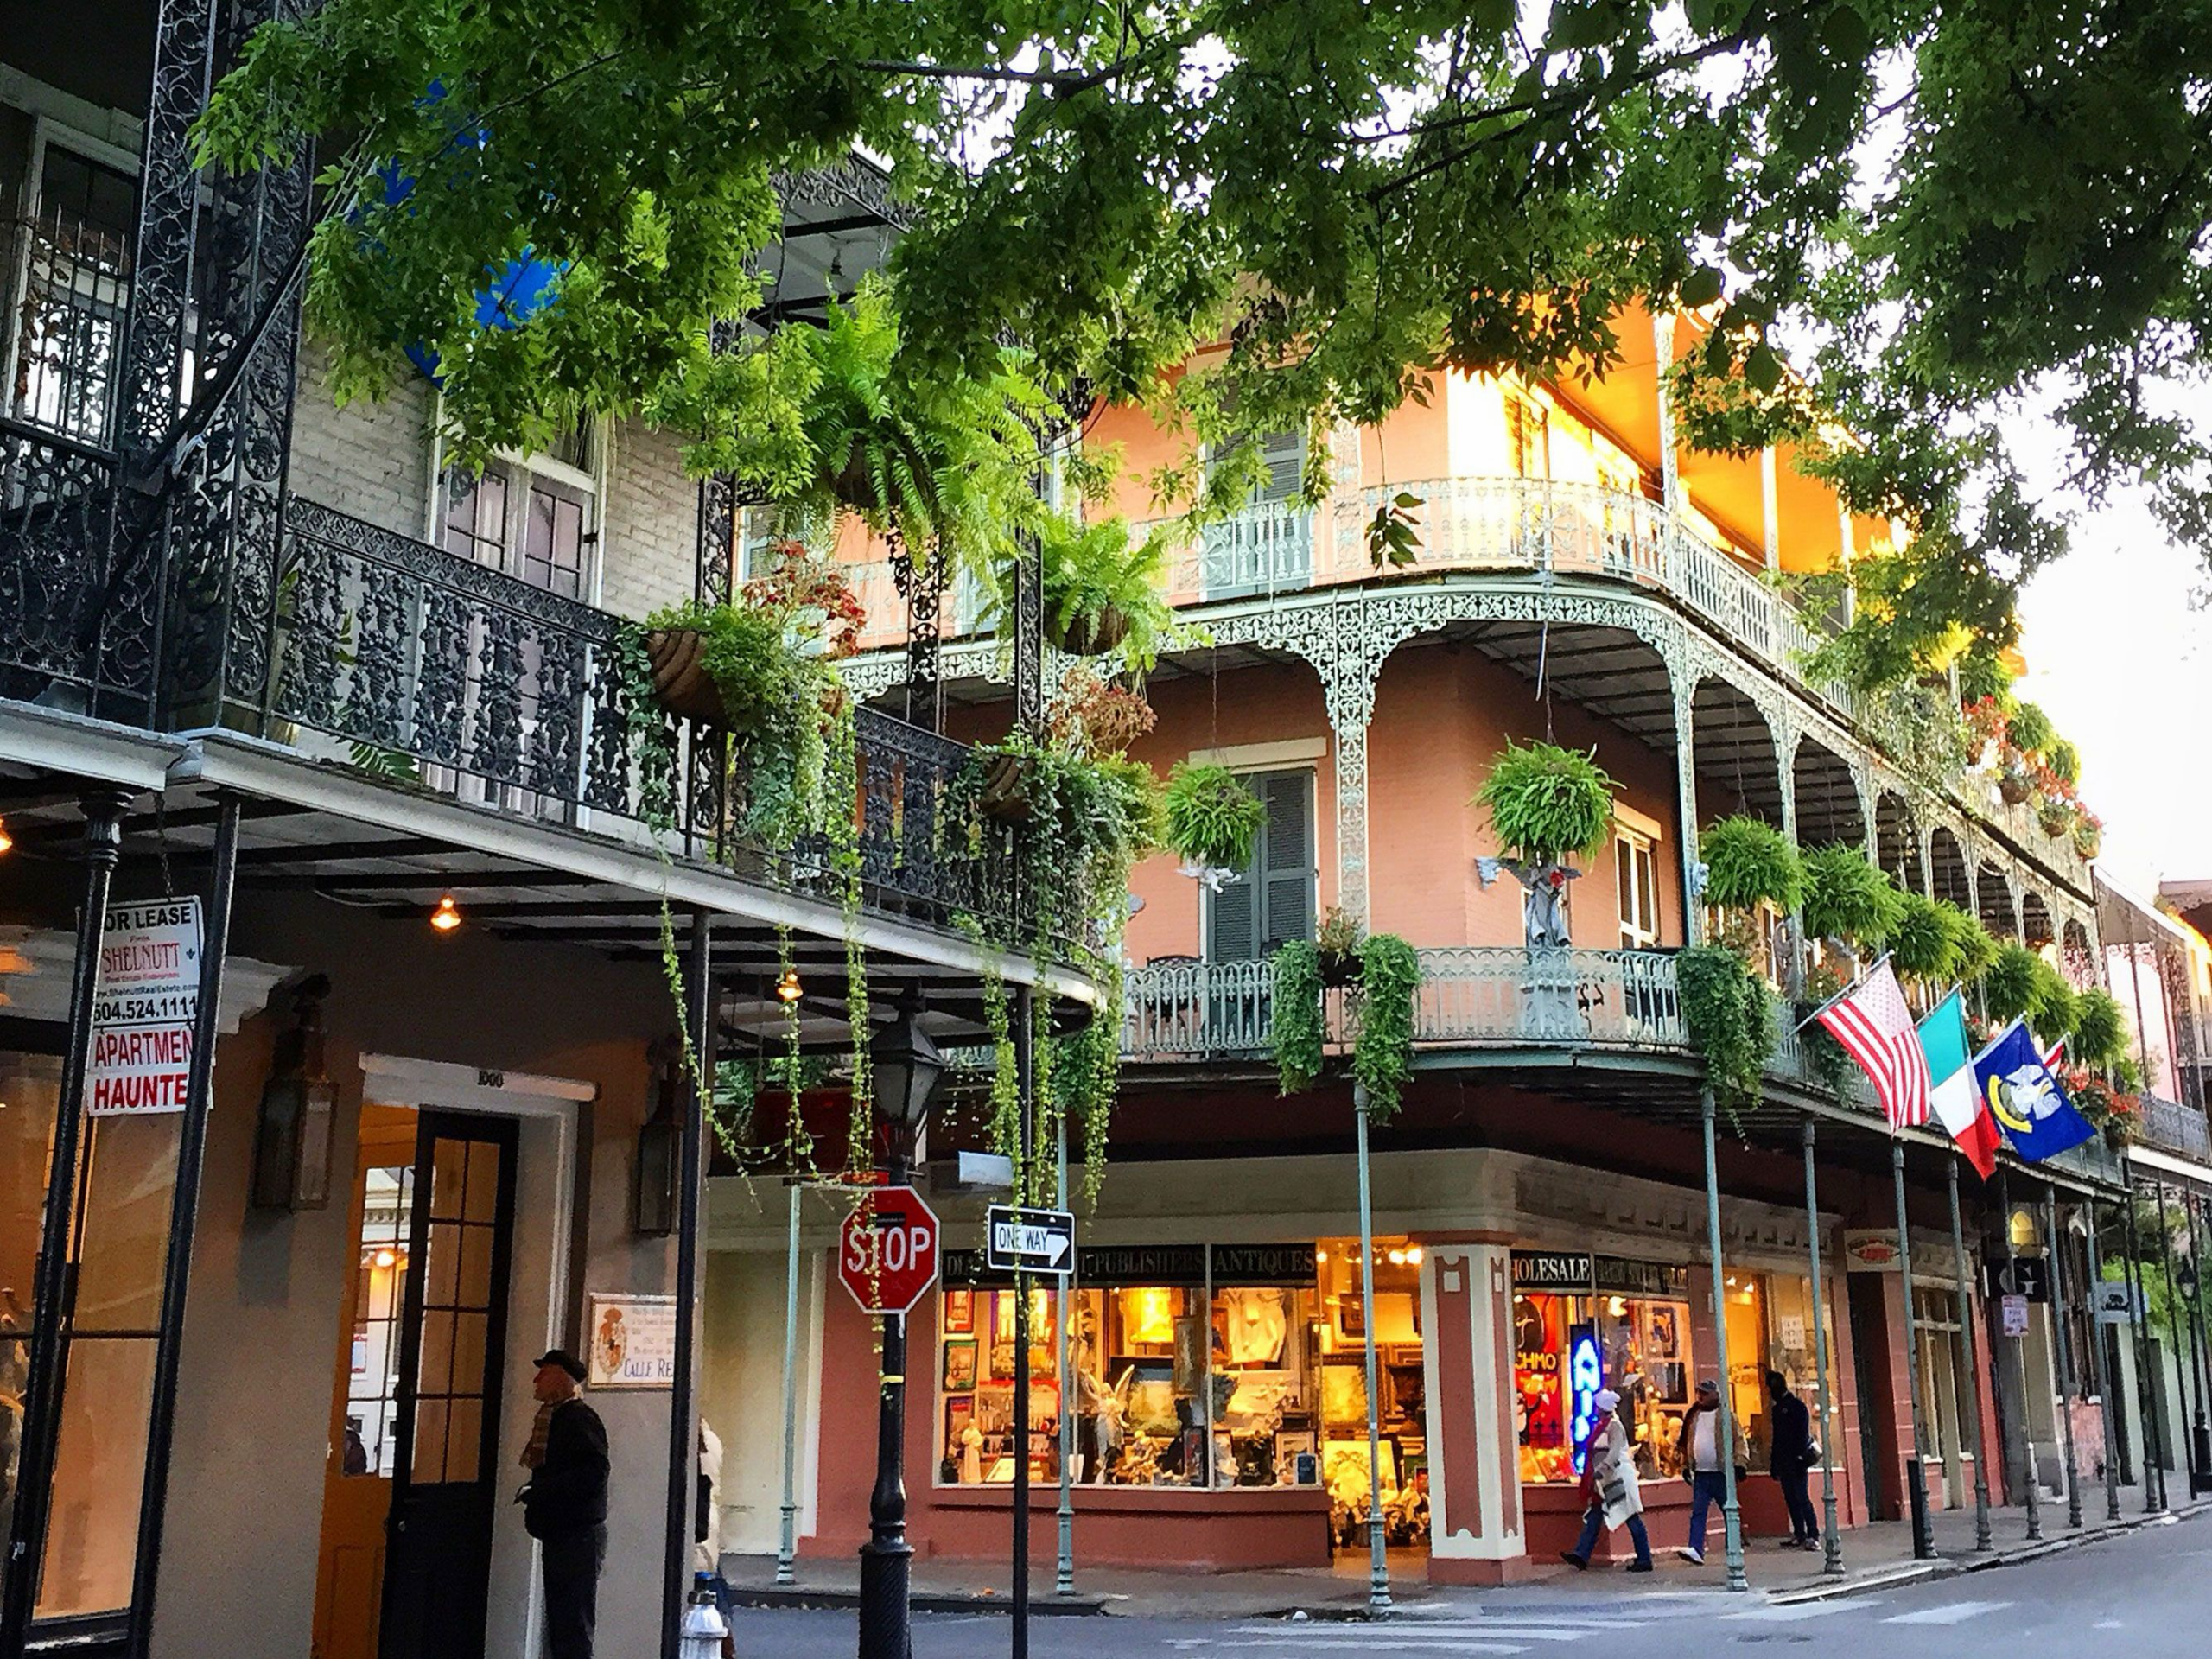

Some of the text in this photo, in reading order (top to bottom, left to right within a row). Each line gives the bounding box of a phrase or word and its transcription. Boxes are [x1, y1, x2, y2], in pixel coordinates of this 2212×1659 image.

[104, 906, 192, 932] OR LEASE
[101, 943, 181, 974] SHELNUTT
[94, 1028, 194, 1067] APARTMEN
[94, 1073, 188, 1111] HAUNTE
[847, 1227, 931, 1273] STOP
[999, 1226, 1048, 1252] ONE WAY
[1214, 1249, 1316, 1275] ANTIQUES
[1511, 1258, 1590, 1281] HOLESALE
[624, 1357, 674, 1377] CALLE RE
[1514, 1351, 1557, 1370] CHMO
